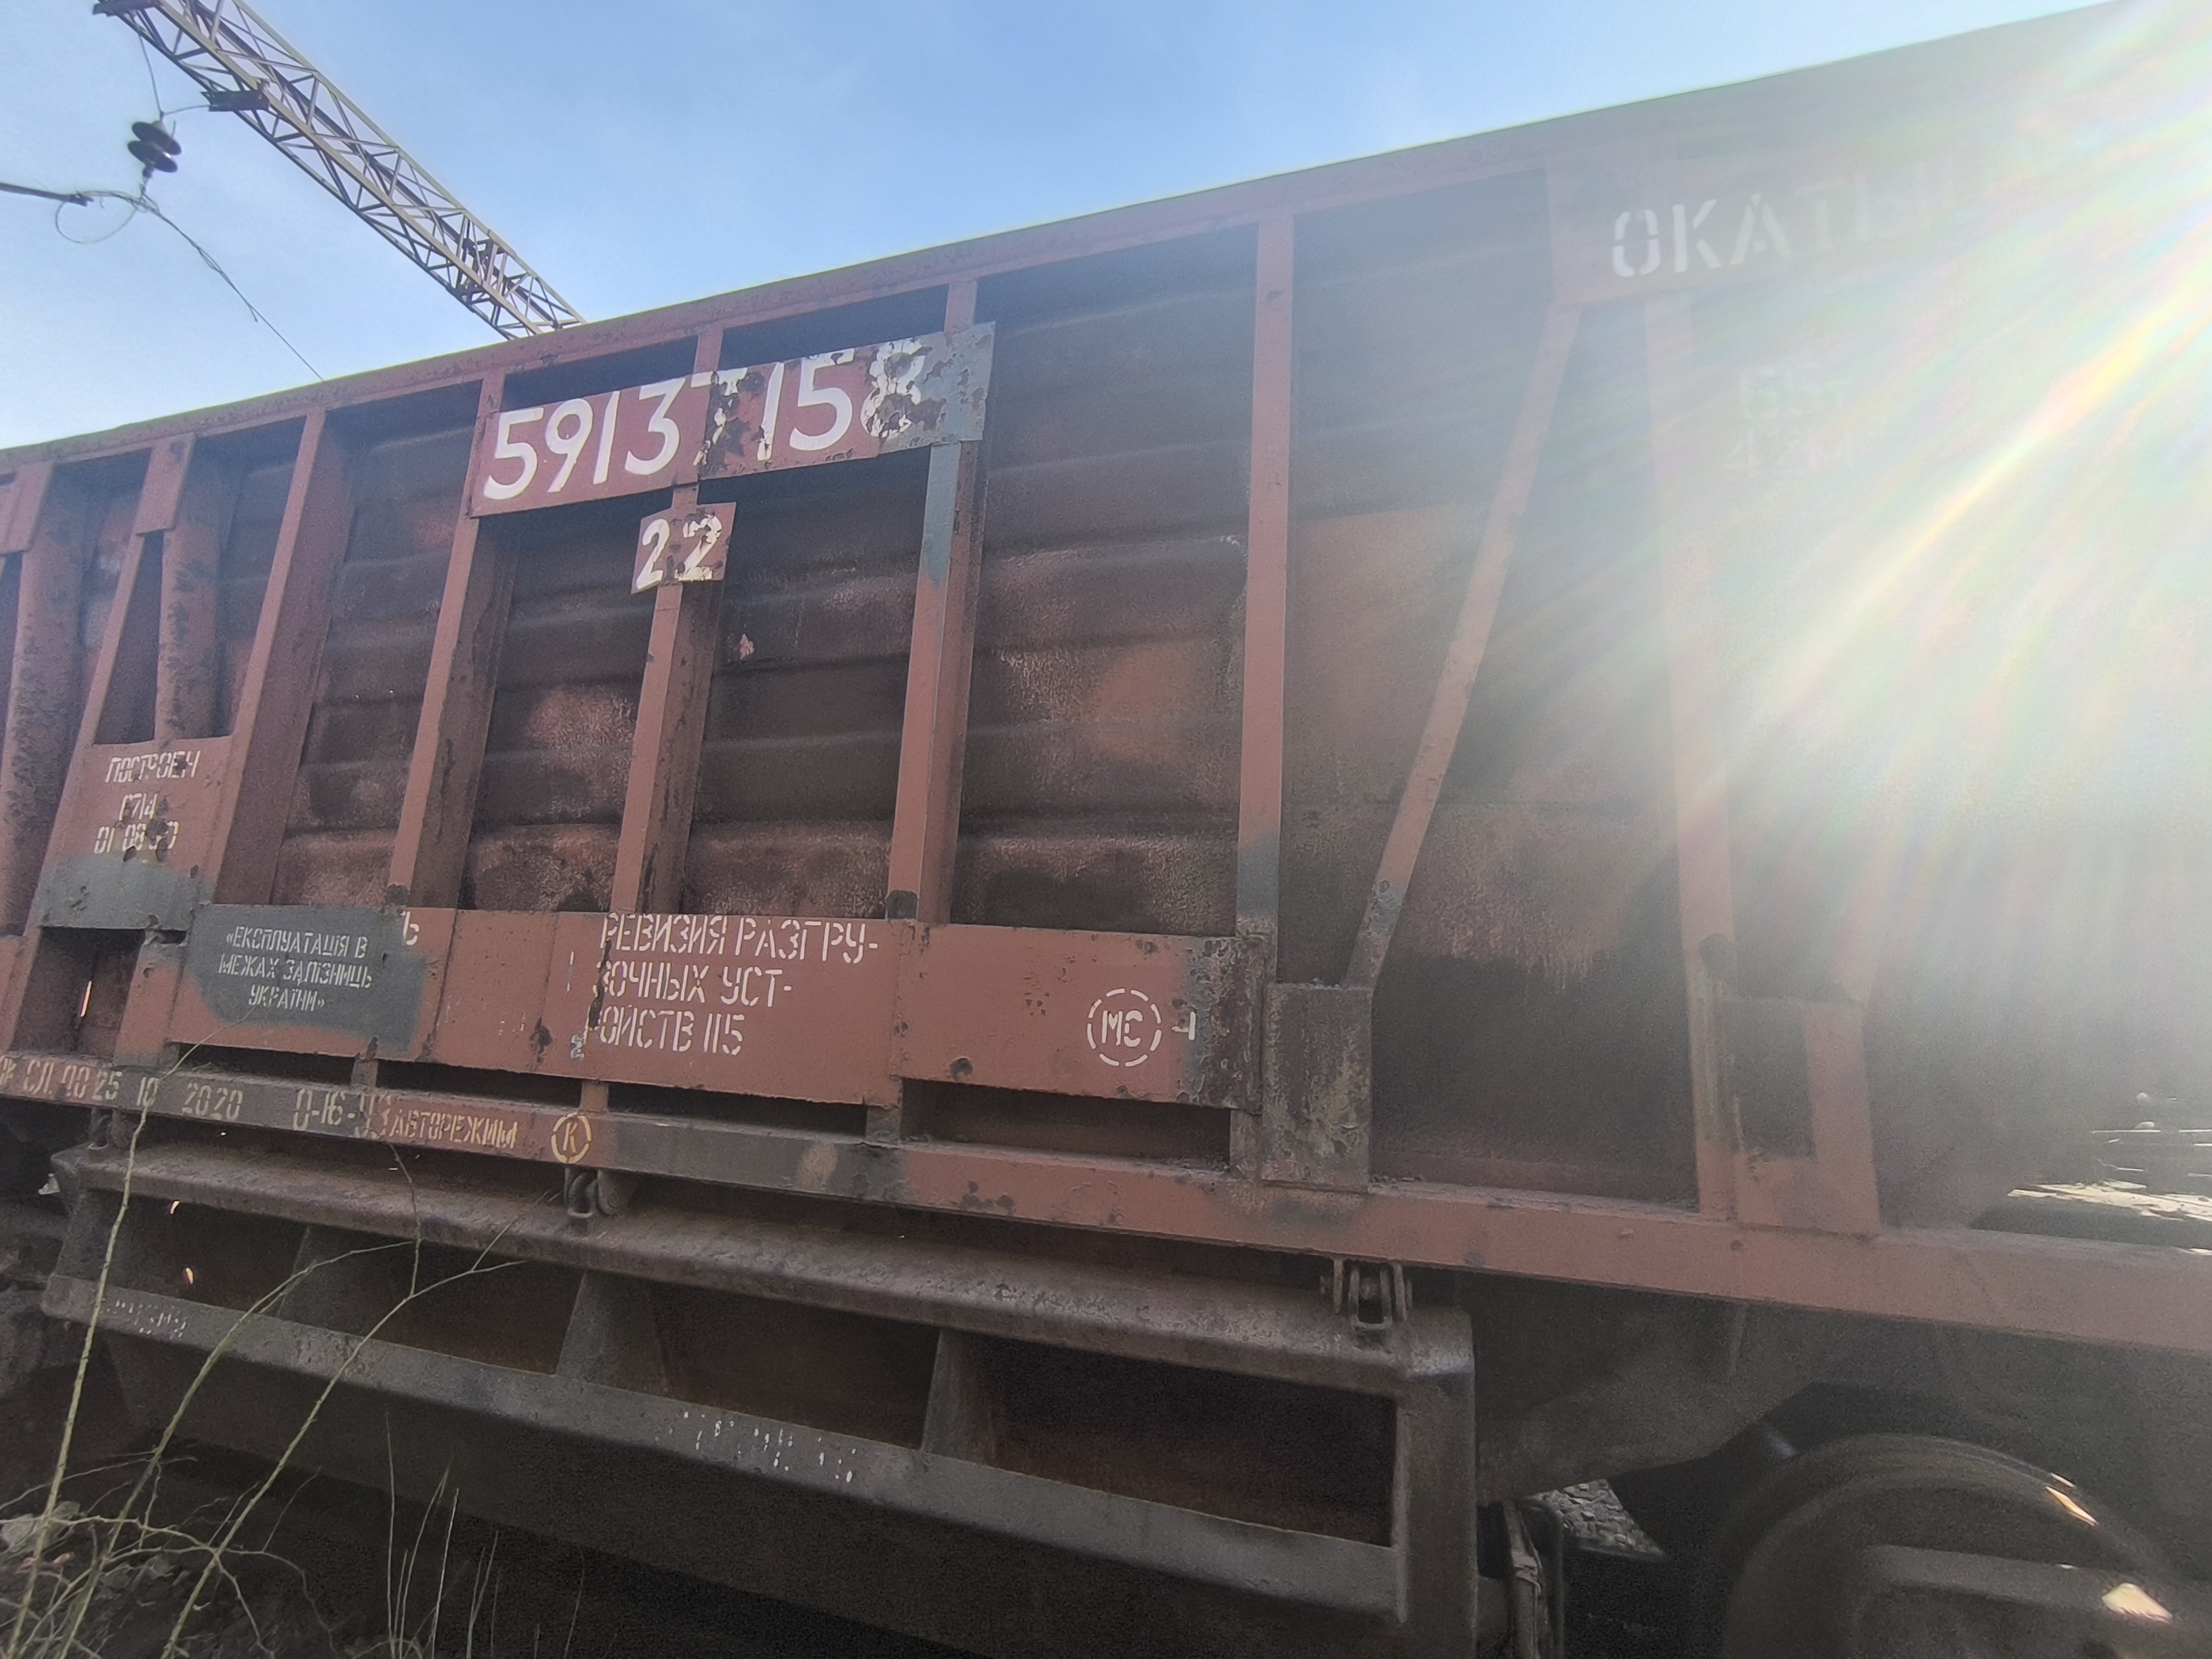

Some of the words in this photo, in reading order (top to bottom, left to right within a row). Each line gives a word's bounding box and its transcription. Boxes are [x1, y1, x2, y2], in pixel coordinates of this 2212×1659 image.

[636, 514, 722, 589] 22
[105, 750, 201, 783] ПОСТРОЕН
[354, 936, 368, 958] В
[600, 912, 728, 955] РЕВИЗИЯ
[735, 917, 878, 964] РАЗГРУ-
[218, 953, 280, 979] МЕЖАХ
[283, 959, 372, 989] ЗАЛІЗНИЦЬ
[720, 966, 792, 1007] УСТ-
[1101, 1010, 1143, 1046] МС
[91, 1067, 123, 1101] 25
[182, 1082, 243, 1120] 2020
